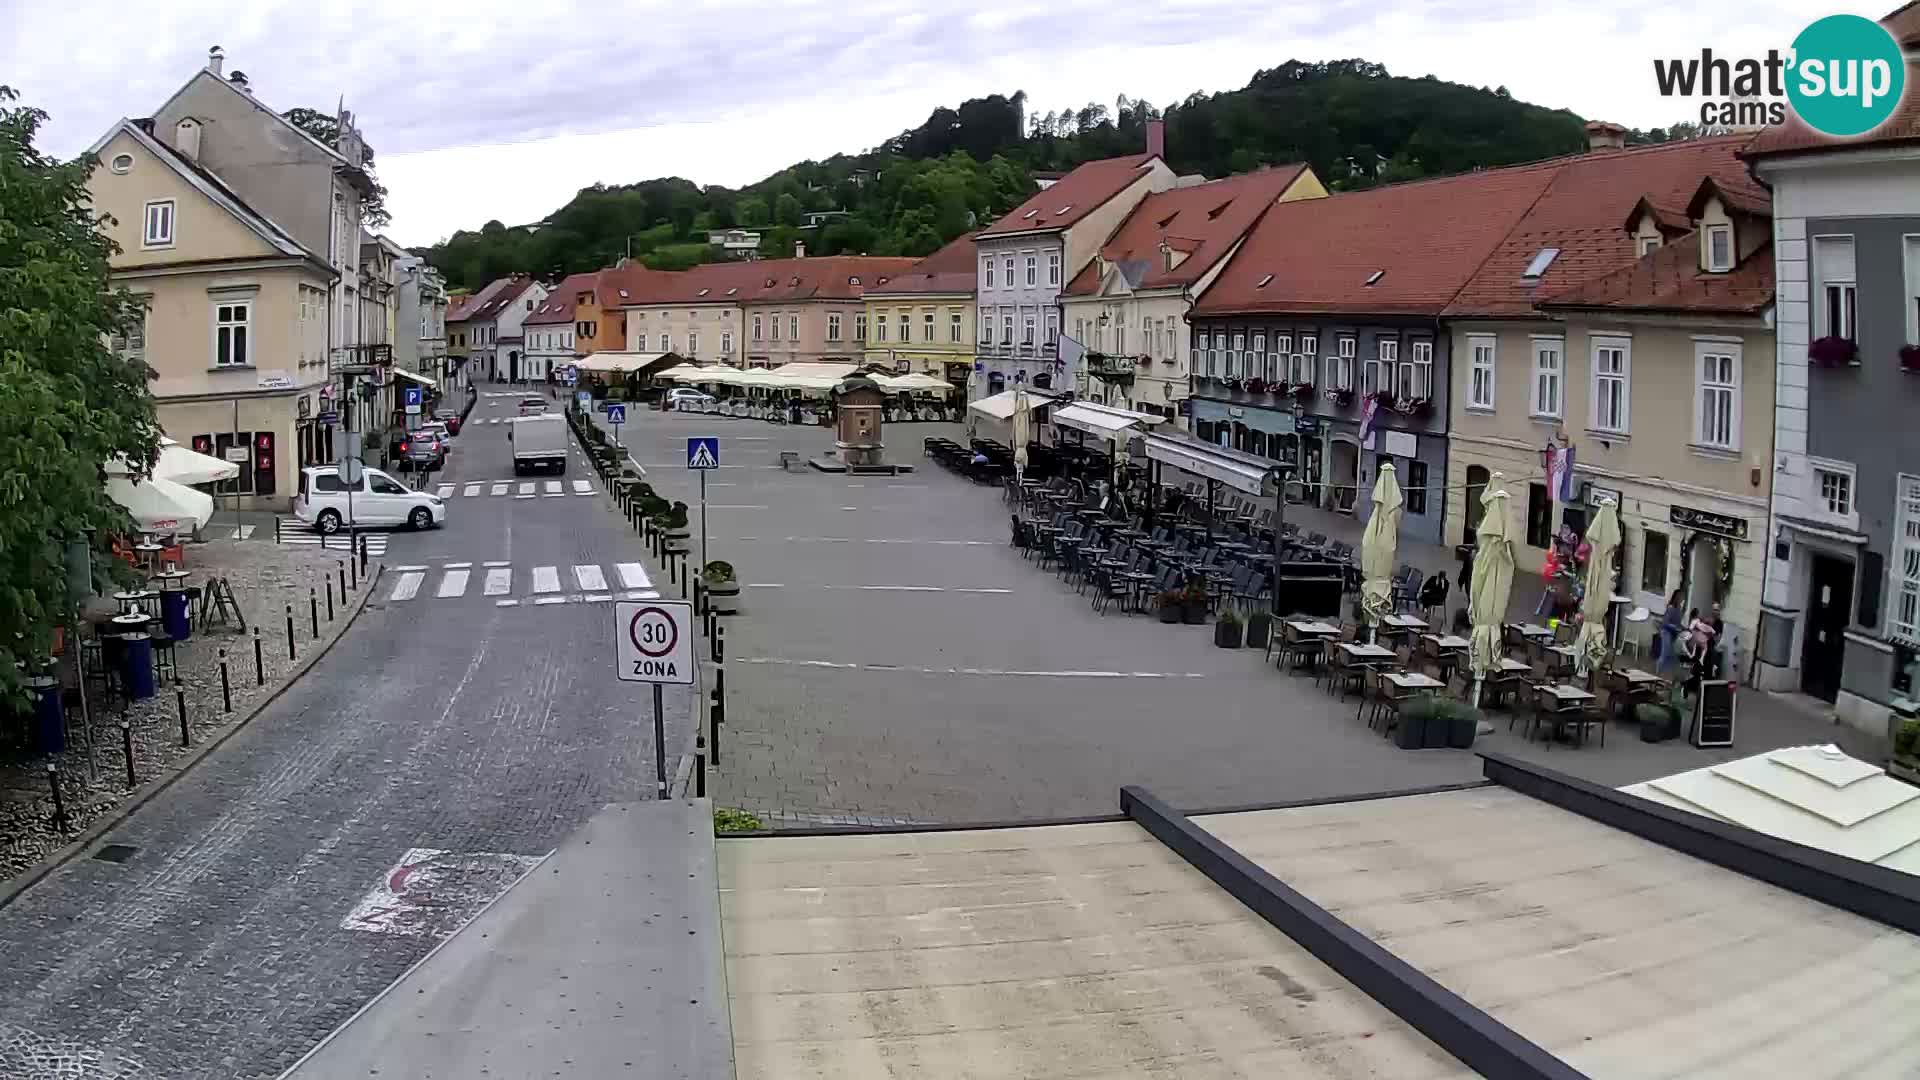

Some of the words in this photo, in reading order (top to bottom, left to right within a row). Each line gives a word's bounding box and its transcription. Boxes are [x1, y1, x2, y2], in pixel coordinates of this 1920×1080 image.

[409, 391, 417, 403] P
[642, 623, 666, 644] 30
[633, 660, 677, 677] ZONA
